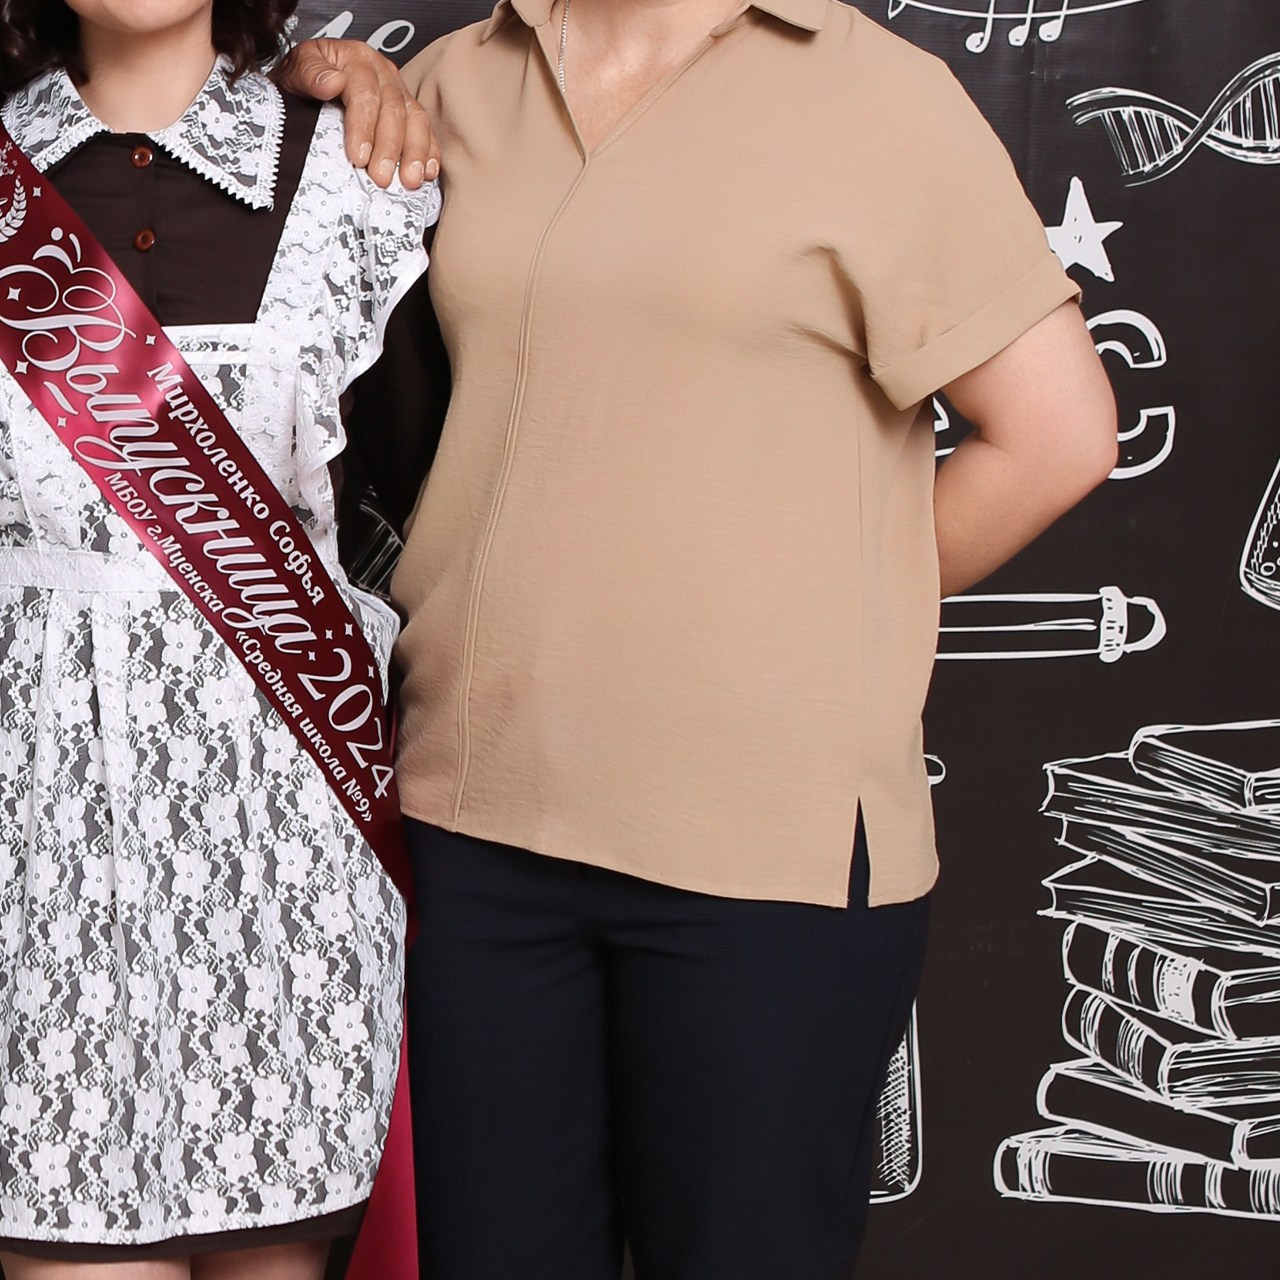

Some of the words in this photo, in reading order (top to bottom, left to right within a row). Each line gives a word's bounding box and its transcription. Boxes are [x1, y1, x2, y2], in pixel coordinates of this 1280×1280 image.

[146, 361, 270, 520] Мирхоленко
[269, 520, 325, 606] Софья
[104, 471, 158, 521] МБОУ
[235, 631, 303, 719] «Средняя
[299, 718, 347, 781] школа
[342, 778, 374, 823] №9»
[297, 647, 394, 799] 2024
